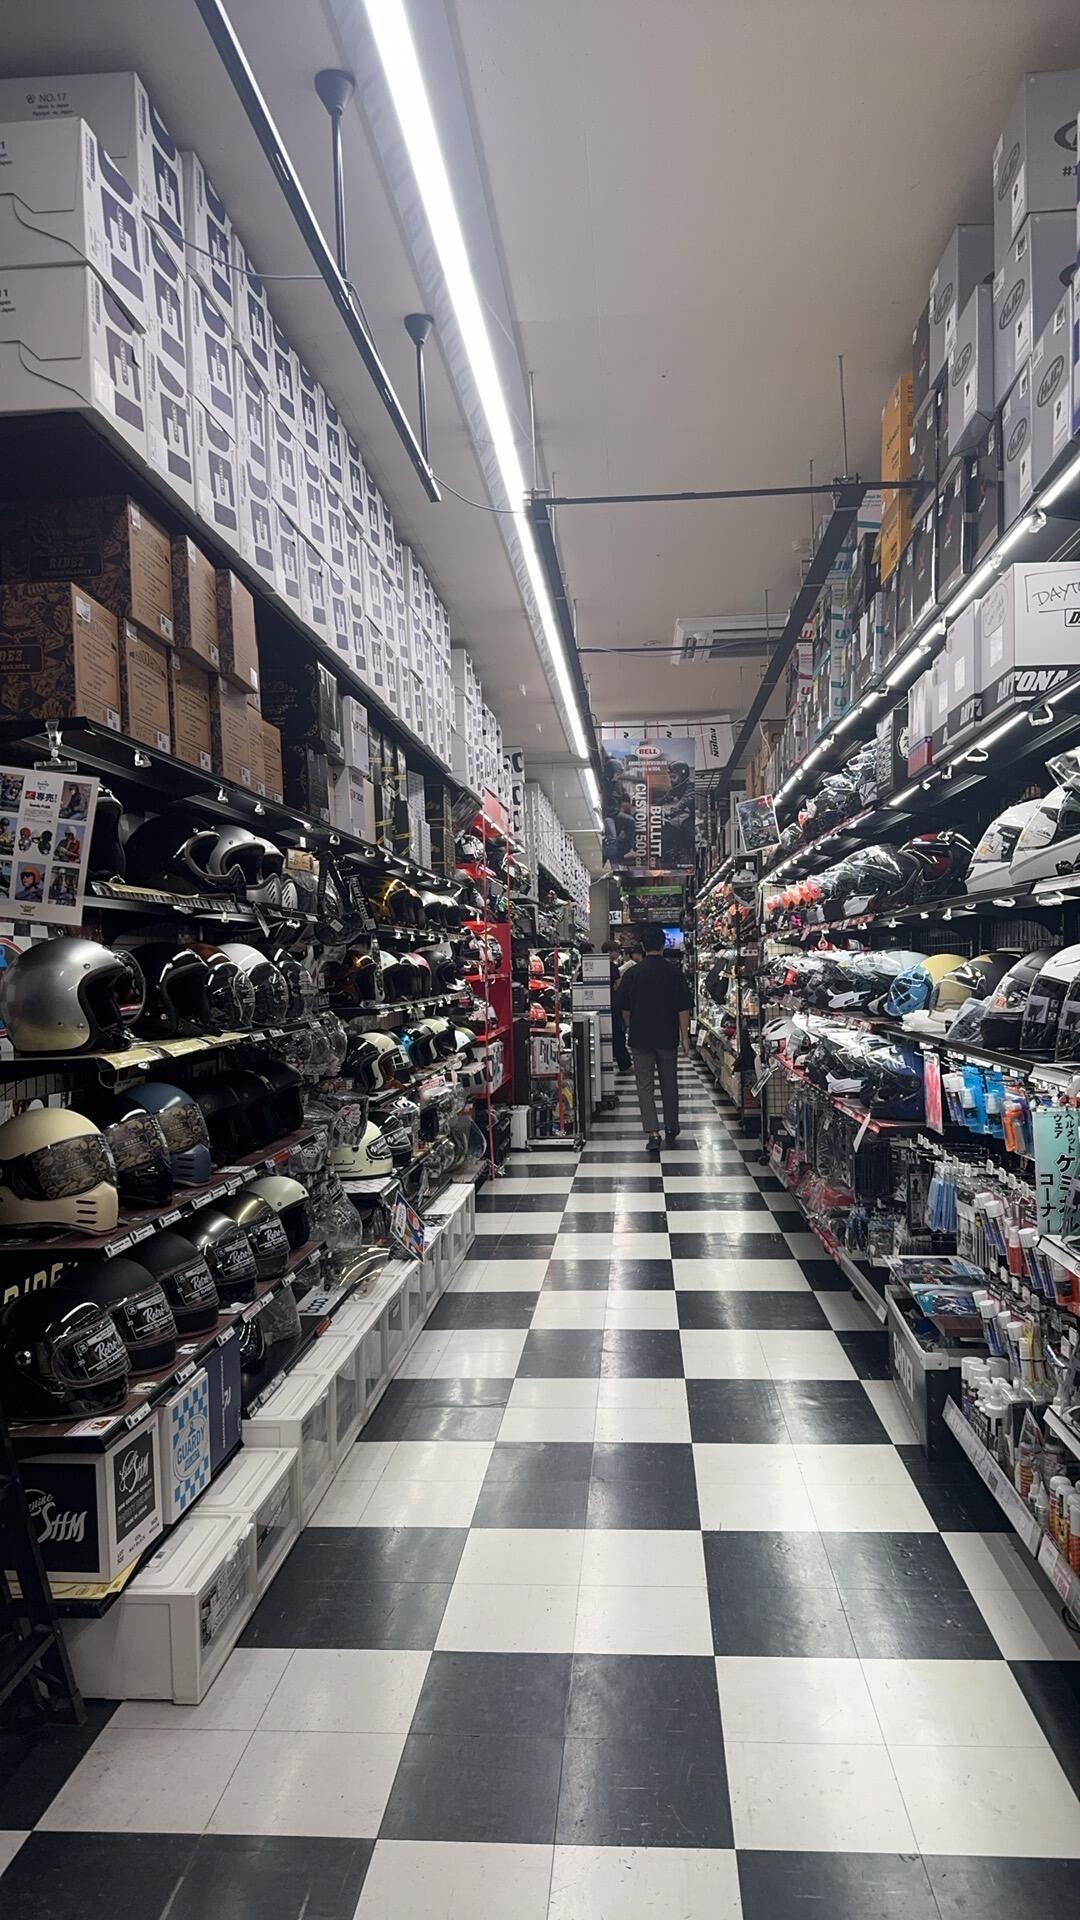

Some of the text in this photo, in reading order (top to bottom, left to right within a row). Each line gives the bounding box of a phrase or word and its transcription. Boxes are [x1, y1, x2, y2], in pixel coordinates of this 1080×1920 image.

[635, 783, 647, 856] CUSTOM 500
[650, 806, 662, 857] BULLITT
[1065, 1114, 1076, 1153] ヘルメット
[1040, 1174, 1056, 1233] コーナー
[177, 1427, 204, 1465] GUARDY
